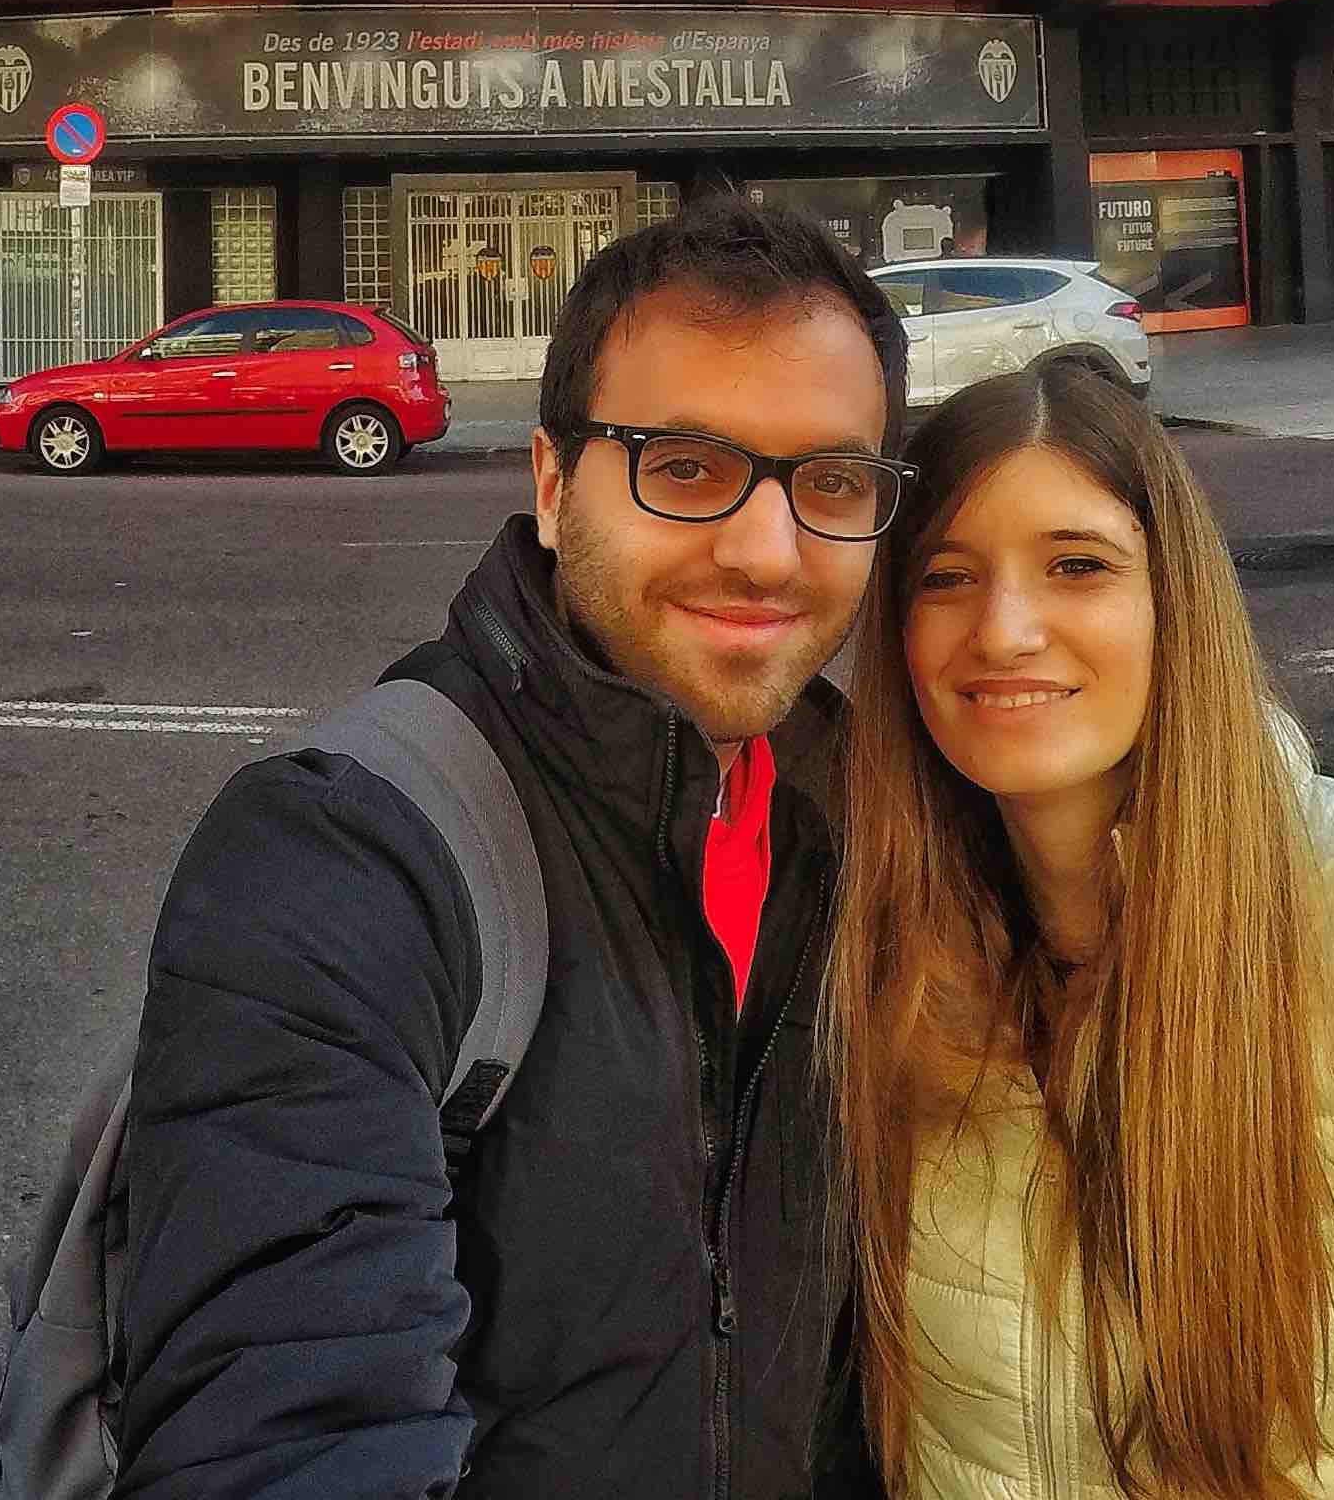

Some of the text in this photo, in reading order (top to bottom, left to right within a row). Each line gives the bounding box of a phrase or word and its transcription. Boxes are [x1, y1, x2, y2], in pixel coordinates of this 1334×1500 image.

[264, 32, 302, 52] Des
[308, 32, 334, 51] de
[342, 31, 399, 51] 1923
[673, 30, 771, 54] d'Espanya
[242, 58, 792, 111] BENVINGUTS A MESTALLA
[117, 170, 135, 181] VIP
[1098, 199, 1152, 220] FUTURO
[1122, 221, 1154, 235] FUTUR
[1117, 238, 1155, 253] FUTURE
